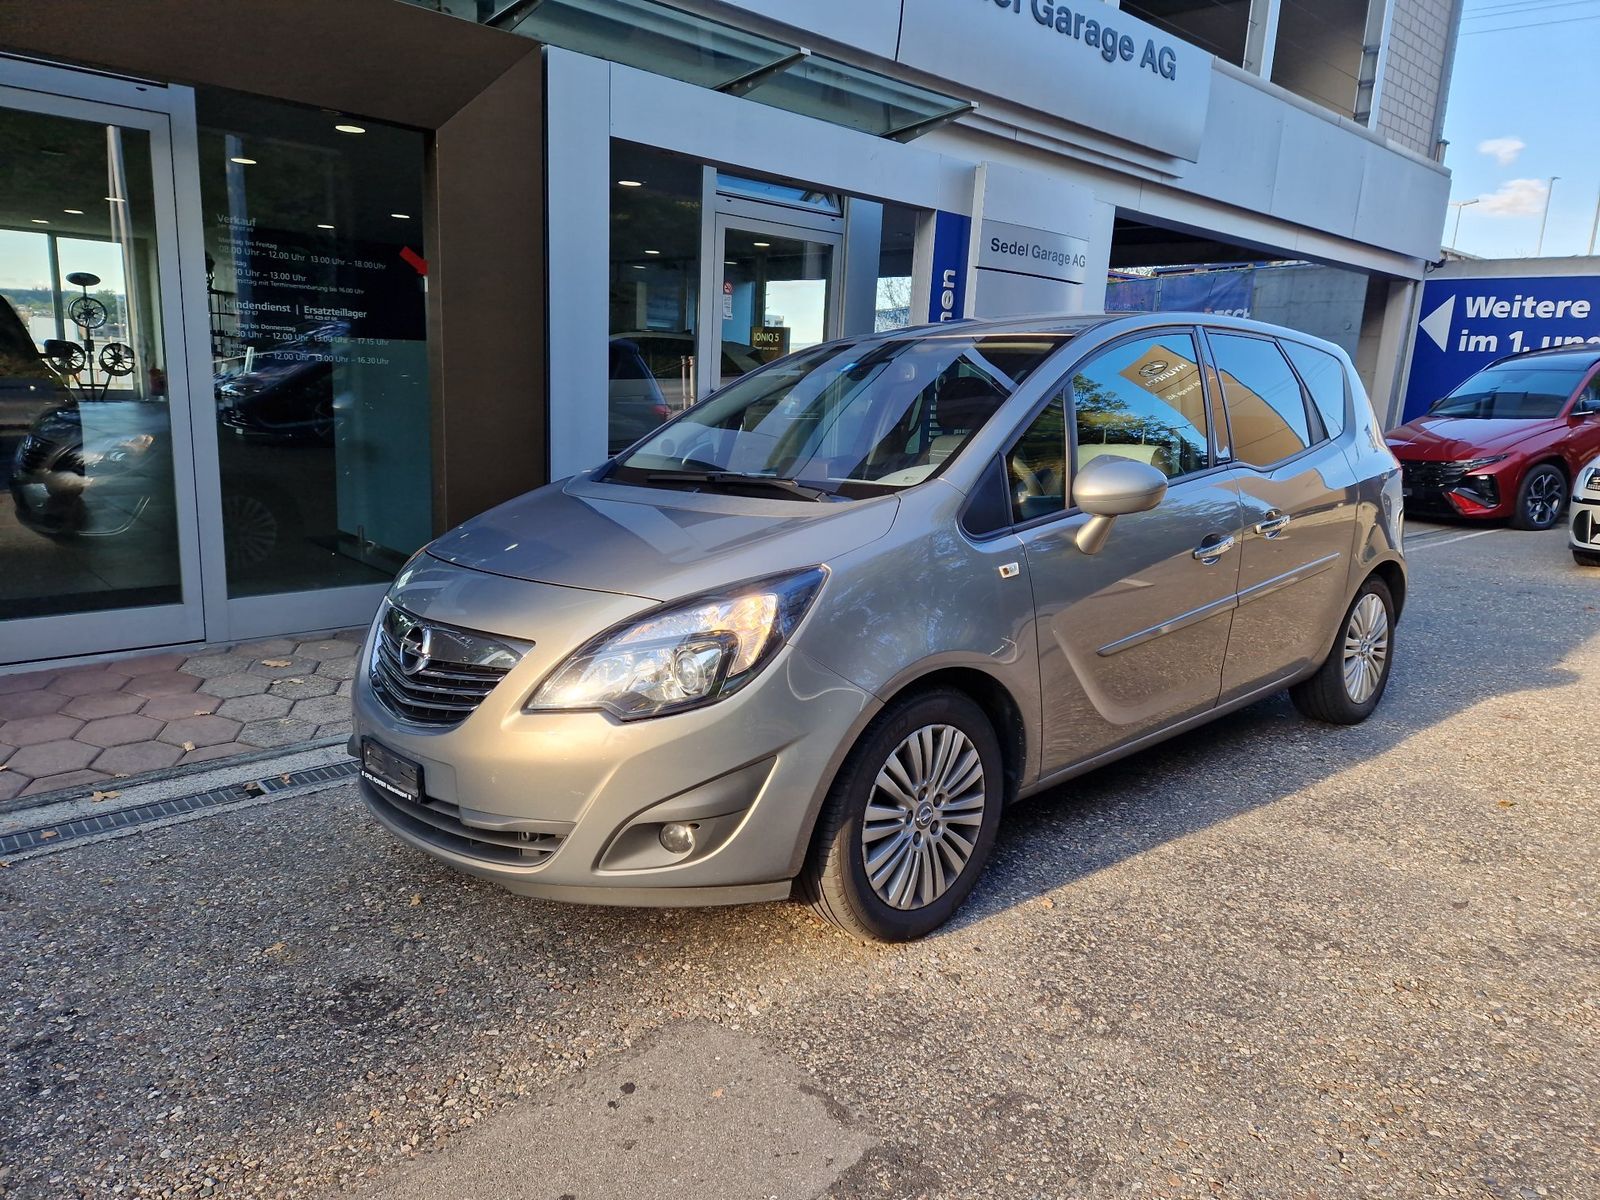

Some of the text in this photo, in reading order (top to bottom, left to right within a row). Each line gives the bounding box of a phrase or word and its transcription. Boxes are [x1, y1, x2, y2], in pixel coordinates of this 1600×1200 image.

[1030, 0, 1177, 81] Garage AG
[216, 213, 257, 227] Verkauf
[256, 241, 278, 250] Freitag
[990, 237, 1086, 268] Sedel Garage AG
[244, 248, 260, 257] Uhr
[269, 250, 290, 260] 12.00
[291, 250, 305, 262] Uhr
[310, 253, 330, 264] 13.00
[331, 256, 346, 266] Uhr
[354, 259, 373, 269] 18.00
[373, 259, 387, 270] Uhr
[245, 268, 260, 277] Uhr
[269, 270, 290, 281] 13.00
[292, 271, 307, 282] Uhr
[304, 305, 367, 320] Ersatzteillager
[1465, 294, 1591, 319] Weitere
[250, 322, 260, 330] bis
[261, 323, 296, 333] Donnerstag
[248, 330, 263, 339] Uhr
[272, 332, 292, 341] 12.00
[753, 332, 780, 343] IONIQ 5
[1458, 329, 1498, 352] im
[1508, 330, 1530, 353] 1.
[273, 351, 294, 361] 12.00
[295, 353, 310, 361] Uhr
[315, 354, 334, 362] 13.00
[335, 355, 349, 363] Uhr
[357, 356, 375, 364] 16.30
[376, 357, 390, 365] Uhr
